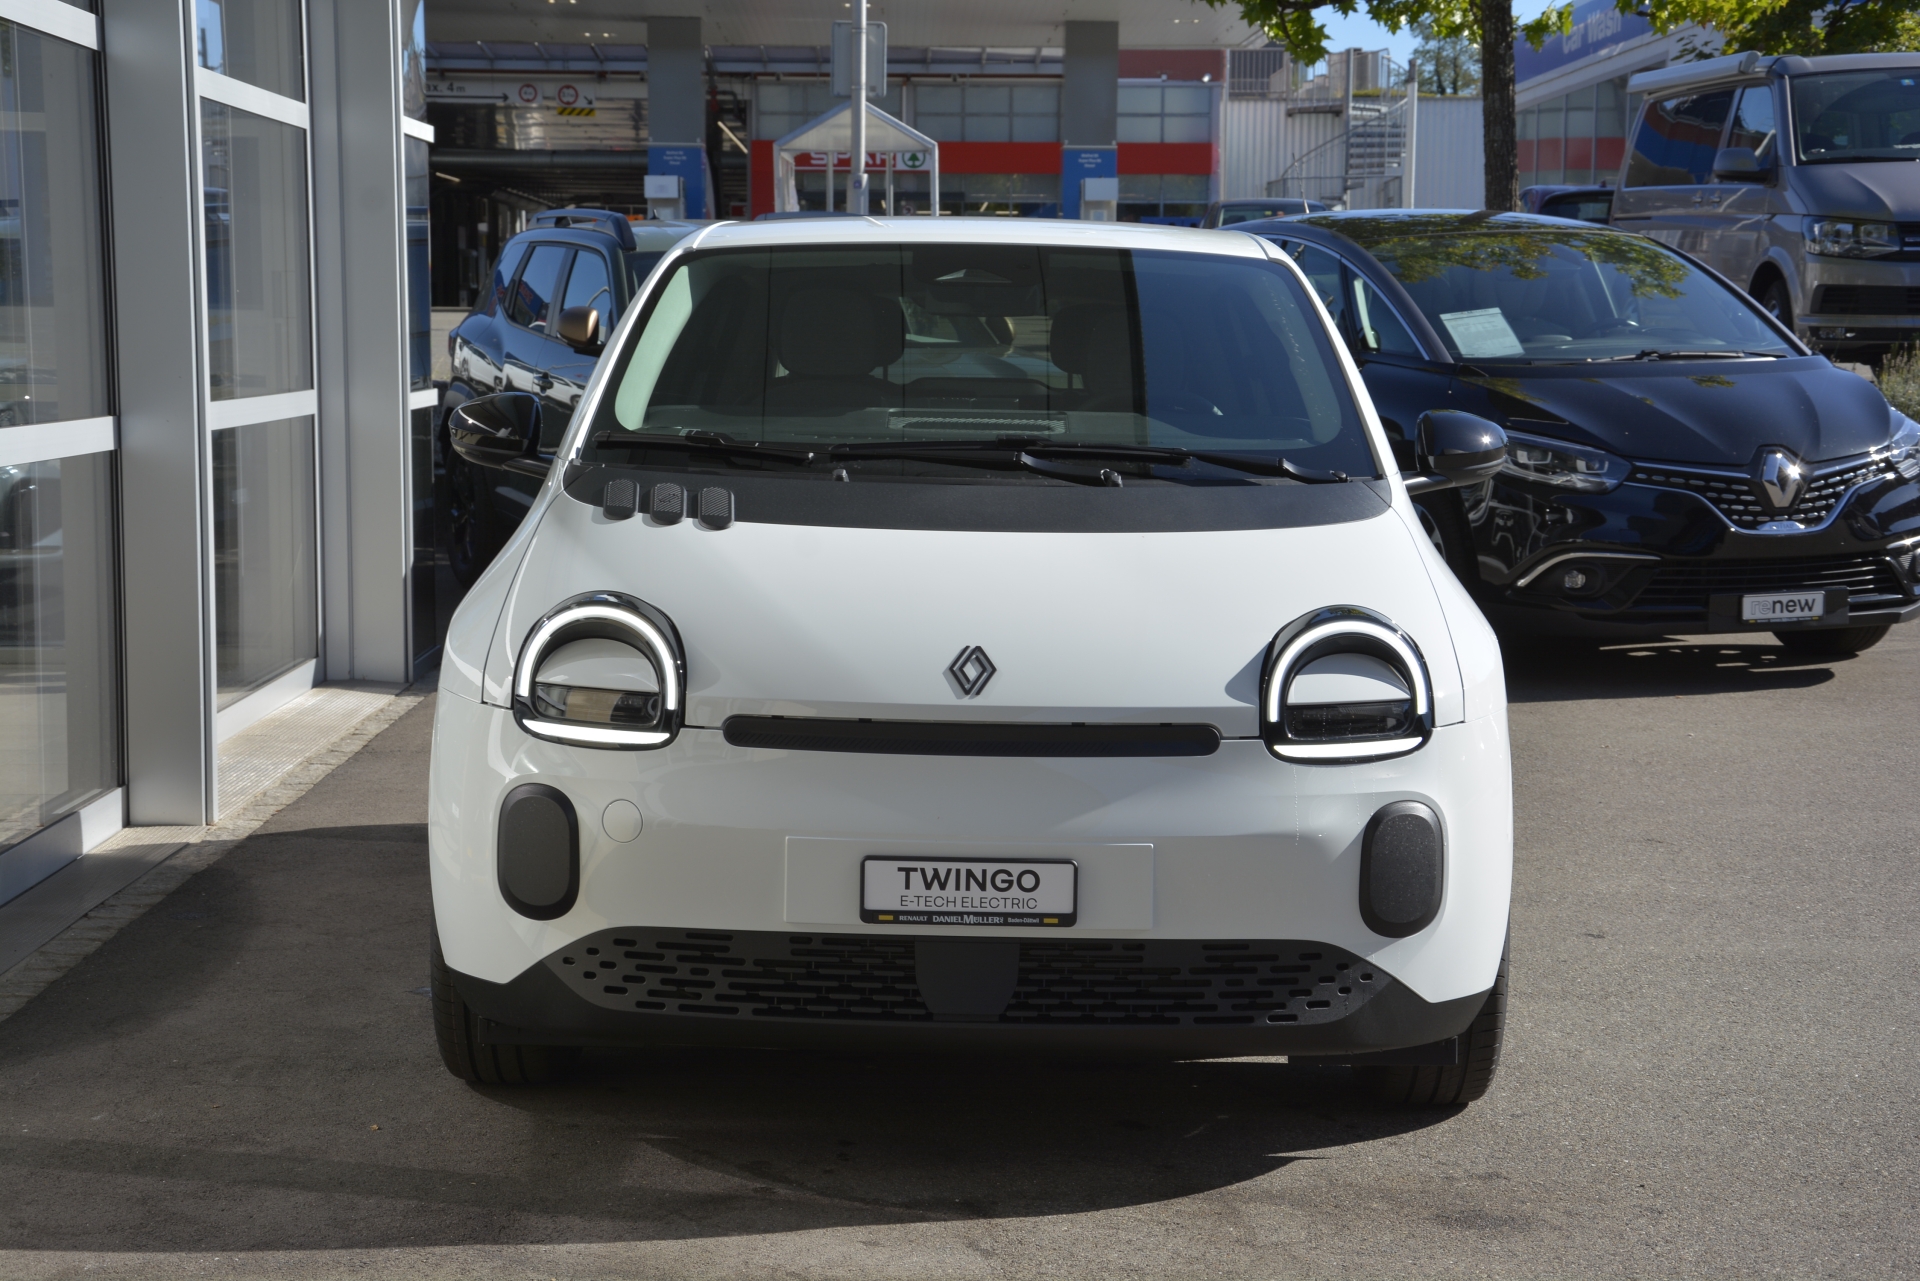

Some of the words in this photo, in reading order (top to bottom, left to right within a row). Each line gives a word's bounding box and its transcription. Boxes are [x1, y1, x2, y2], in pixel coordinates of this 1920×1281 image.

[1588, 8, 1623, 44] Wash
[446, 82, 454, 92] 4
[1750, 598, 1816, 616] renew
[897, 866, 1041, 893] TWINGO
[900, 895, 957, 908] E-TECH
[961, 897, 1038, 909] ELECTRIC
